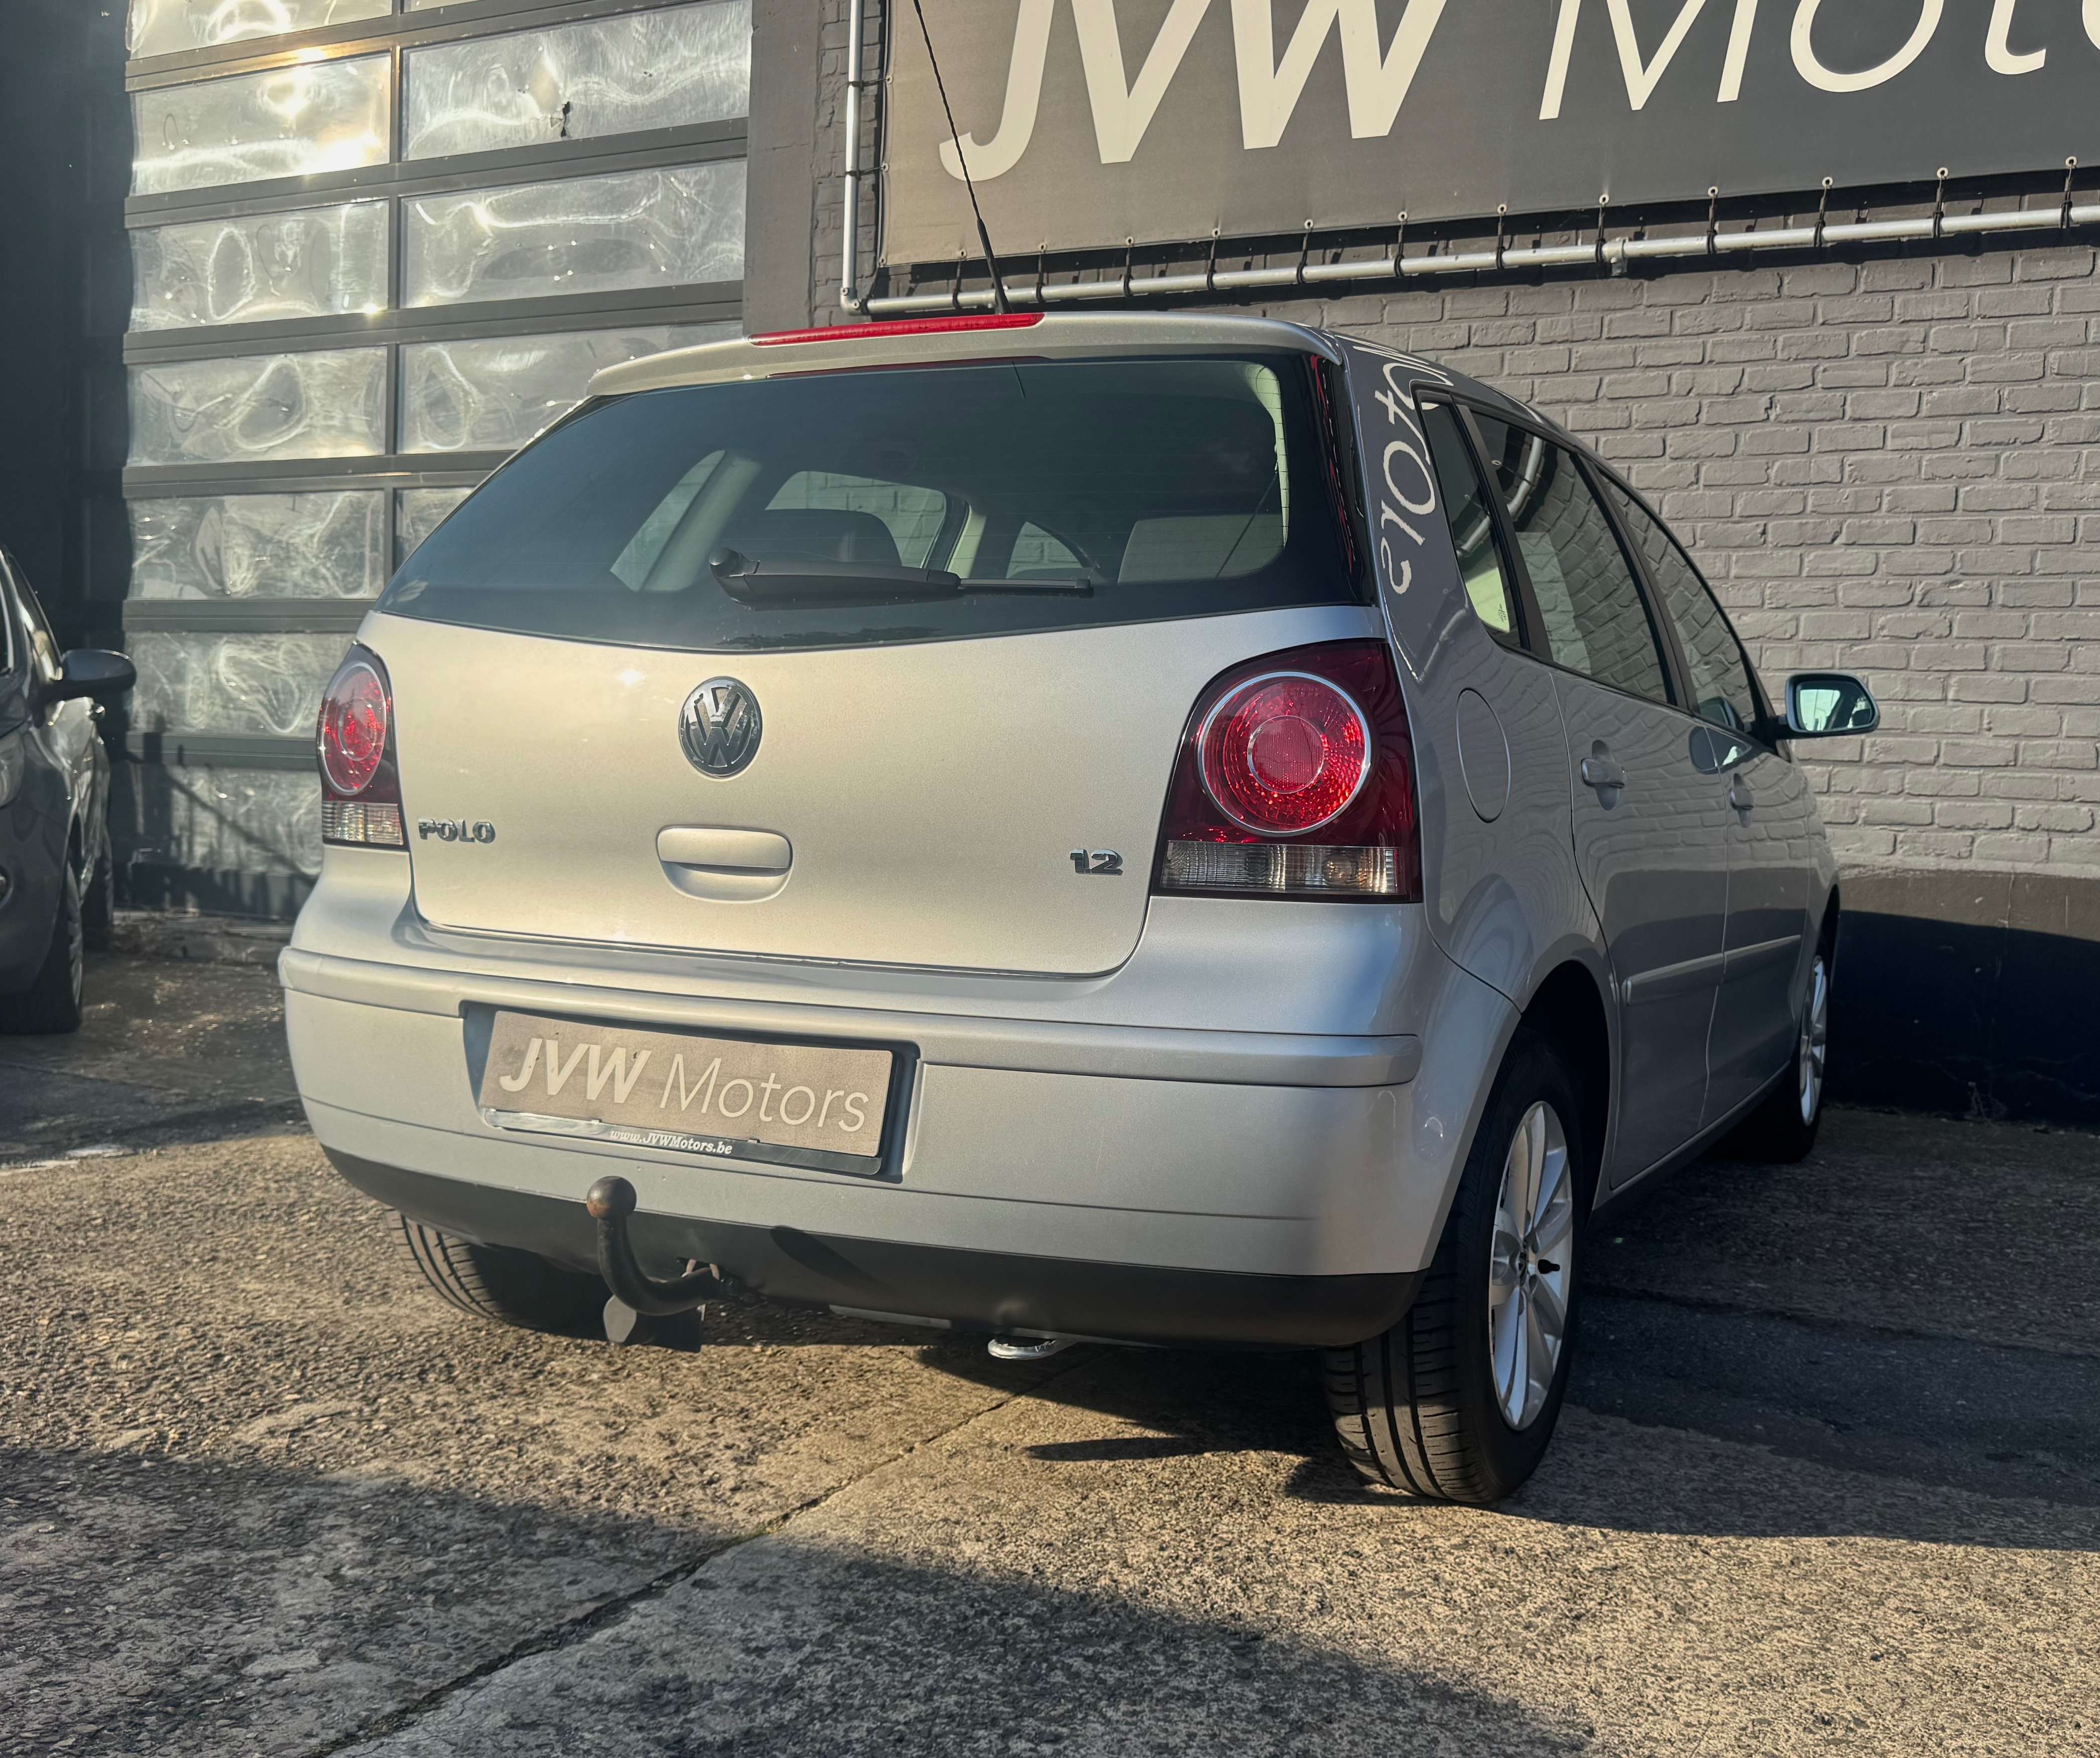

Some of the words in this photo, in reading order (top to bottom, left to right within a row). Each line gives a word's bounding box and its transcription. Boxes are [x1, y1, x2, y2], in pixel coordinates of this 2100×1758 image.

[940, 0, 1446, 182] JVW
[418, 818, 496, 844] POLO
[499, 1037, 652, 1104] JVW
[660, 1053, 869, 1133] Motors
[610, 1130, 733, 1155] www.JVWMotors.be
